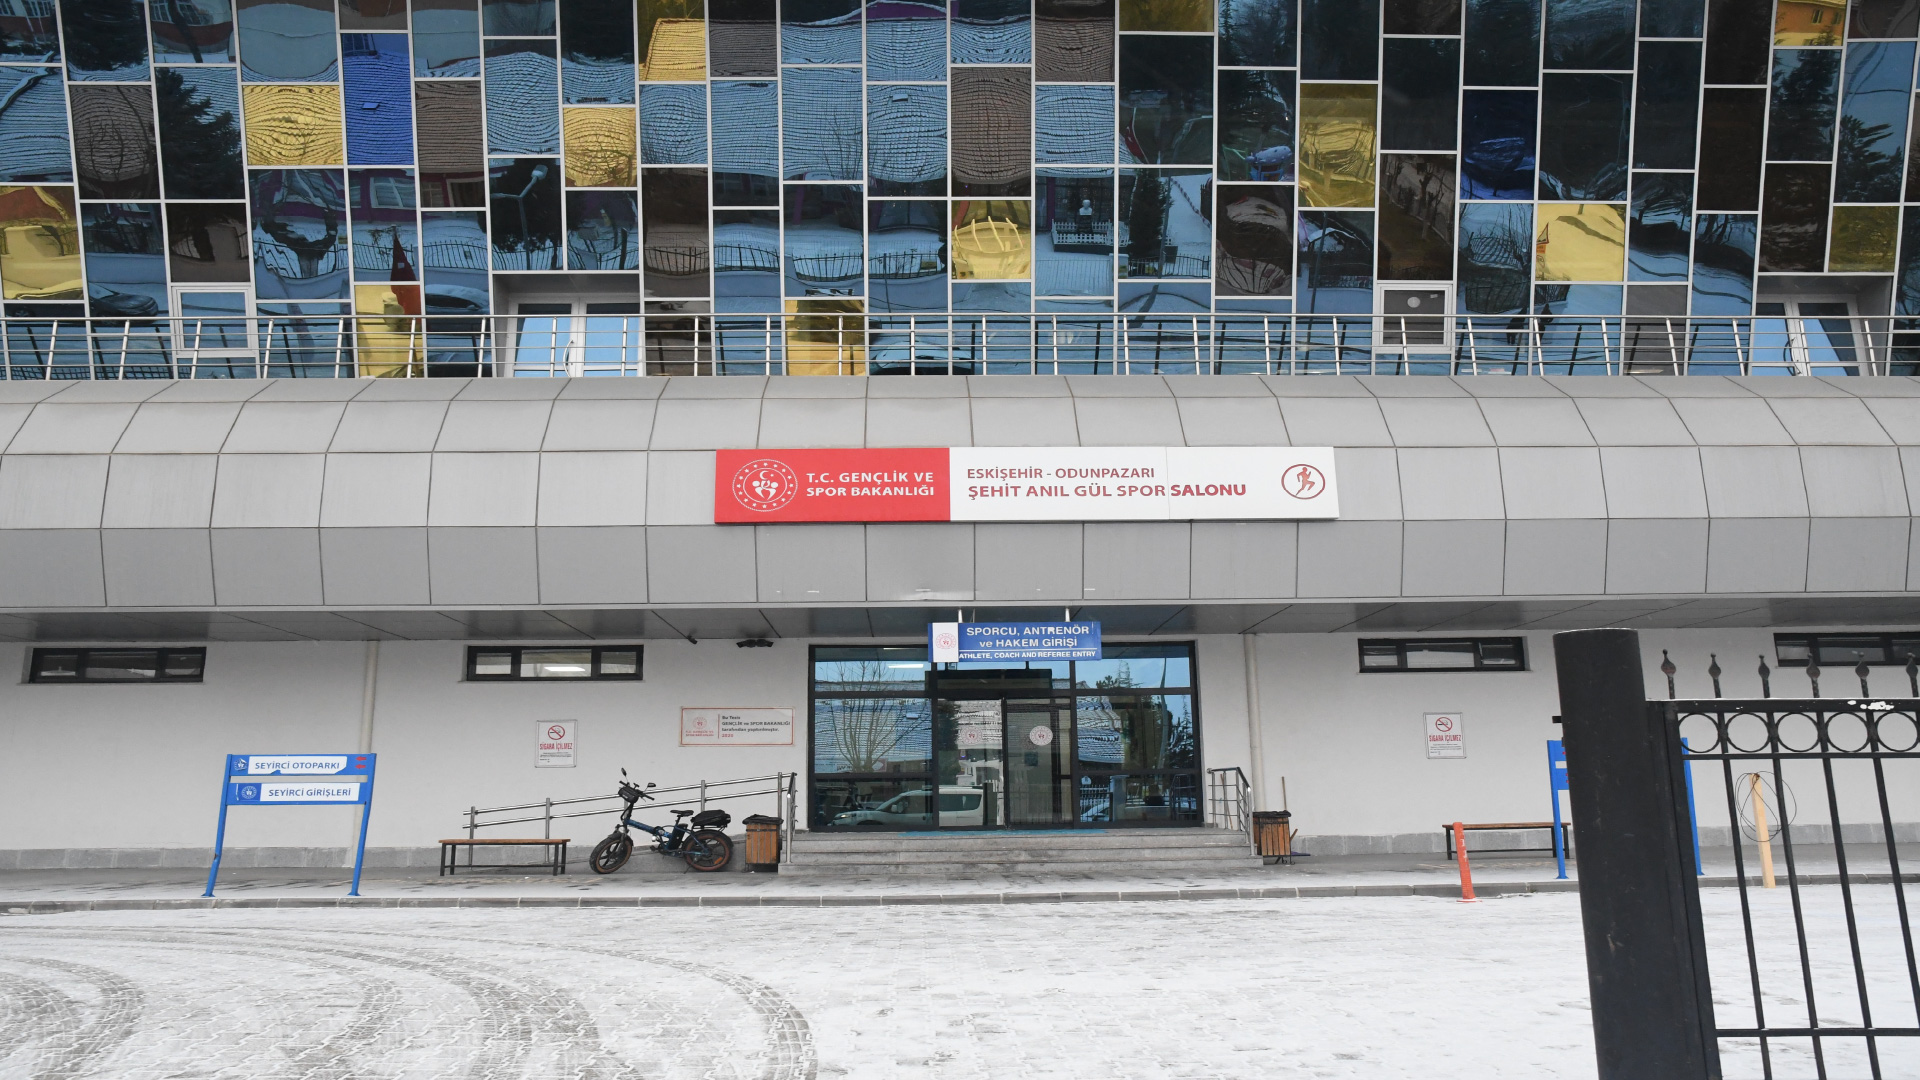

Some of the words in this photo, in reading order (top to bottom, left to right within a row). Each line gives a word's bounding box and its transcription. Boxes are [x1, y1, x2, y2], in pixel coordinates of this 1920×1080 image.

[806, 472, 834, 483] T.C.
[839, 470, 909, 485] GENÇLİK
[914, 472, 934, 482] VE
[967, 465, 1043, 481] ESKİŞEHİR
[1055, 467, 1155, 479] ODUNPAZARI
[806, 487, 847, 497] SPOR
[851, 485, 934, 497] BAKANLIĞI
[969, 482, 1022, 500] ŞEHİT
[1026, 485, 1069, 497] ANIL
[1074, 482, 1112, 497] GÜL
[1116, 484, 1166, 497] SPOR
[1170, 484, 1247, 497] SALONU
[966, 626, 1020, 636] SPORCU,
[1023, 624, 1089, 635] ANTRENÖR
[996, 638, 1039, 647] HAKEM
[1042, 636, 1078, 648] GİRİŞİ
[1072, 650, 1096, 658] ENTRY
[255, 761, 290, 770] SEYİRCİ
[292, 762, 340, 770] OTOPARKI
[268, 787, 304, 797] SEYİRCİ
[306, 787, 352, 798] GİRİŞLERİ
